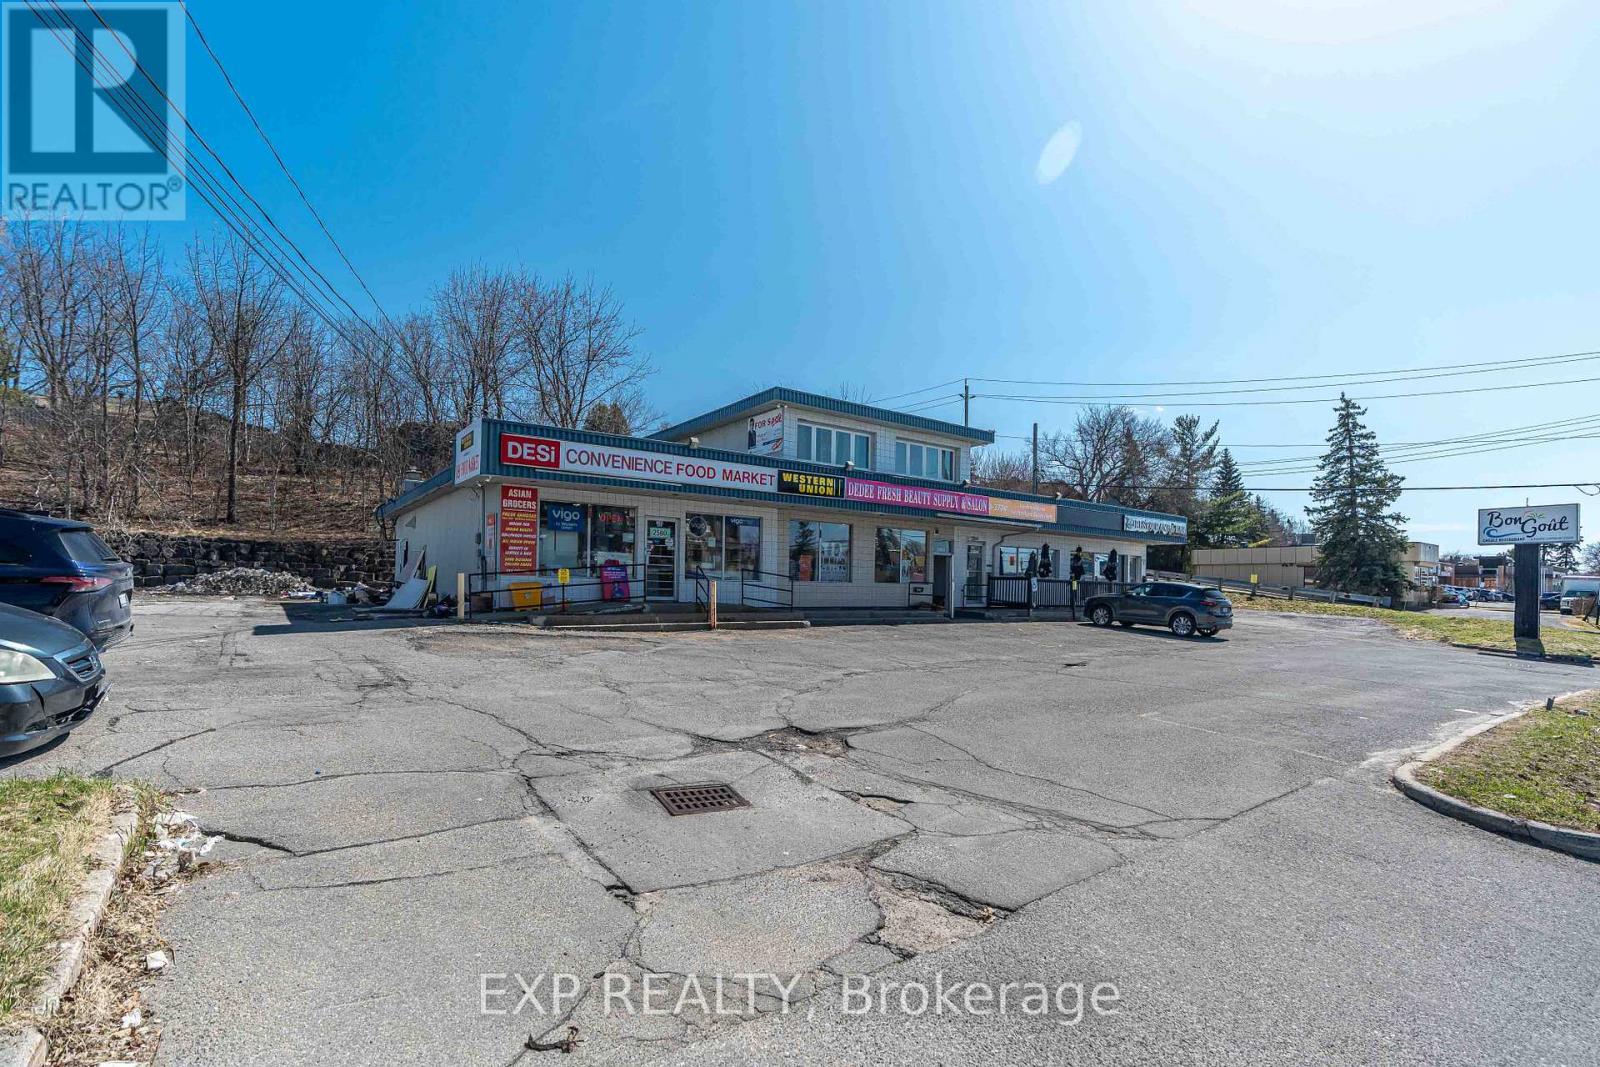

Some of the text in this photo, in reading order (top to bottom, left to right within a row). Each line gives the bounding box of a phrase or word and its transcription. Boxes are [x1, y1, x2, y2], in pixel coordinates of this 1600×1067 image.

[566, 449, 673, 475] CONVENIENCE
[676, 463, 717, 480] FOOD
[722, 468, 776, 486] MARKET
[782, 472, 834, 487] WESTERN
[508, 488, 532, 499] ASIAN
[799, 483, 834, 496] UNION
[502, 498, 537, 510] GROCERS
[848, 482, 875, 499] DEDEE
[877, 486, 902, 502] FRESH
[904, 489, 931, 505] BEAUTY
[933, 493, 959, 509] SUPPLY
[966, 497, 988, 512] SALON
[552, 509, 580, 522] vigo
[1487, 511, 1569, 538] Bon Goût
